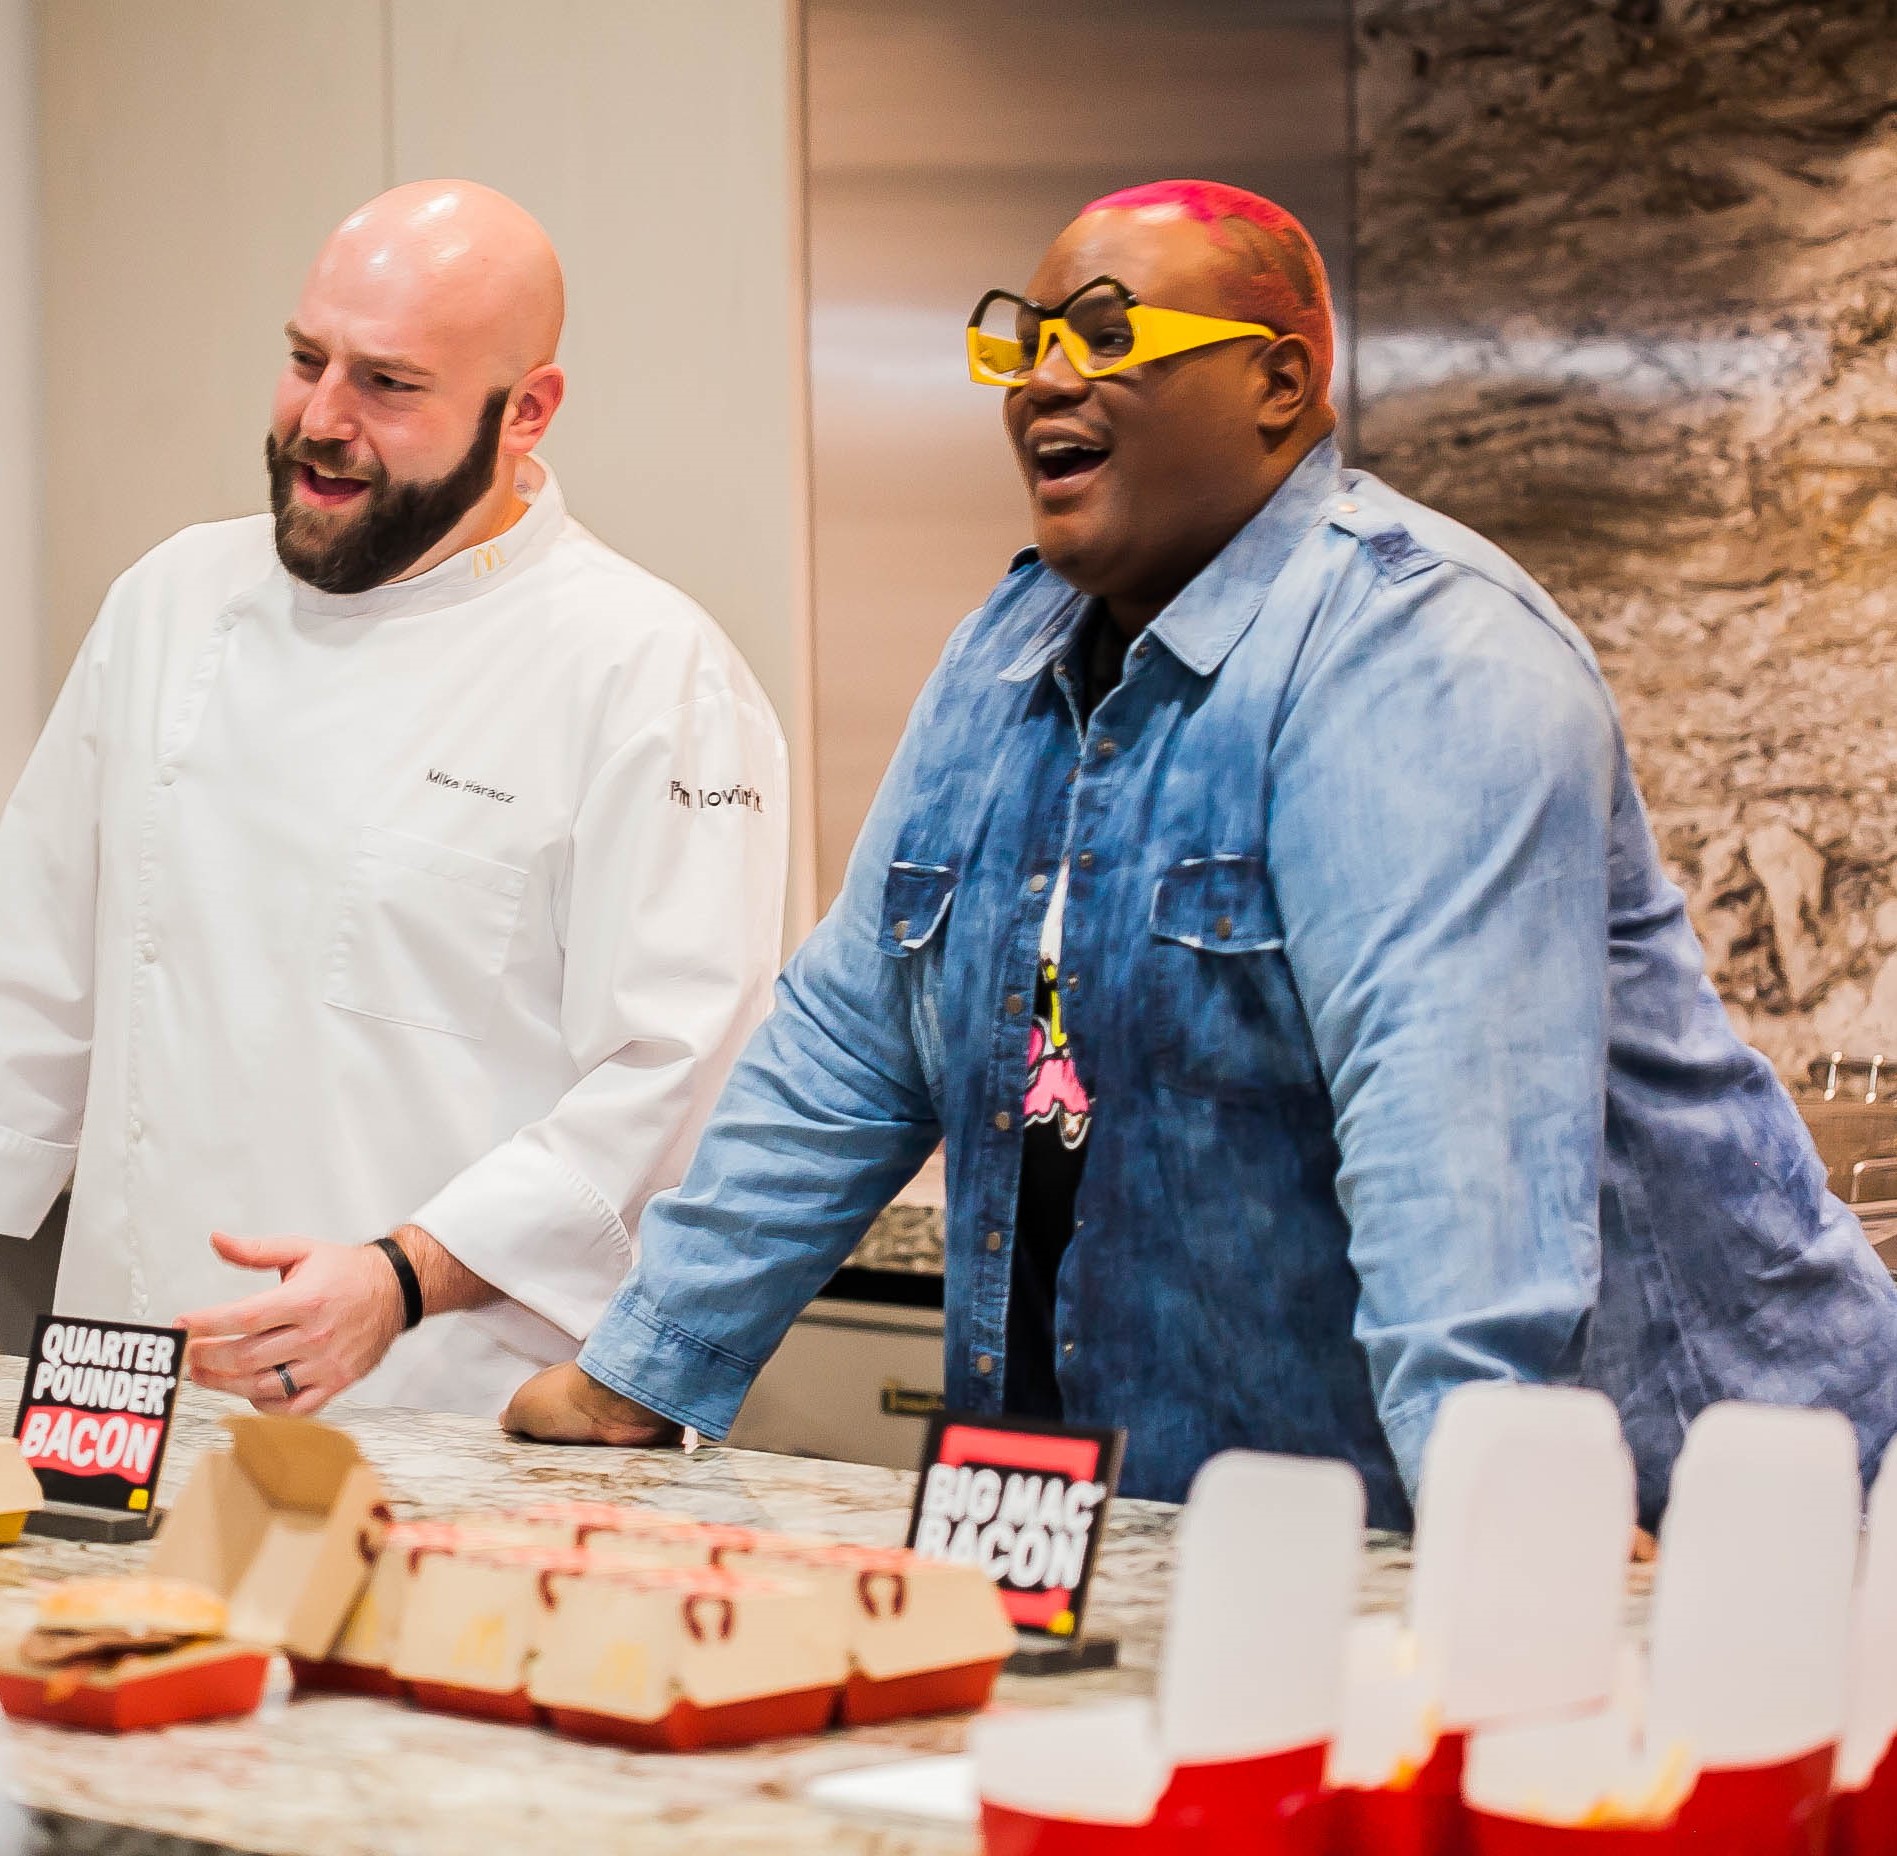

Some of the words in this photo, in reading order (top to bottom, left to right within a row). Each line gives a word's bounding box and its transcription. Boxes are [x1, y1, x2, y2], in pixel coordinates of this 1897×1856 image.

[42, 1323, 175, 1373] QUARTER
[32, 1361, 168, 1415] POUNDER
[20, 1411, 159, 1474] BACON
[921, 1463, 1002, 1525] BIG
[998, 1472, 1098, 1531] MAC
[914, 1515, 1088, 1588] BACON
